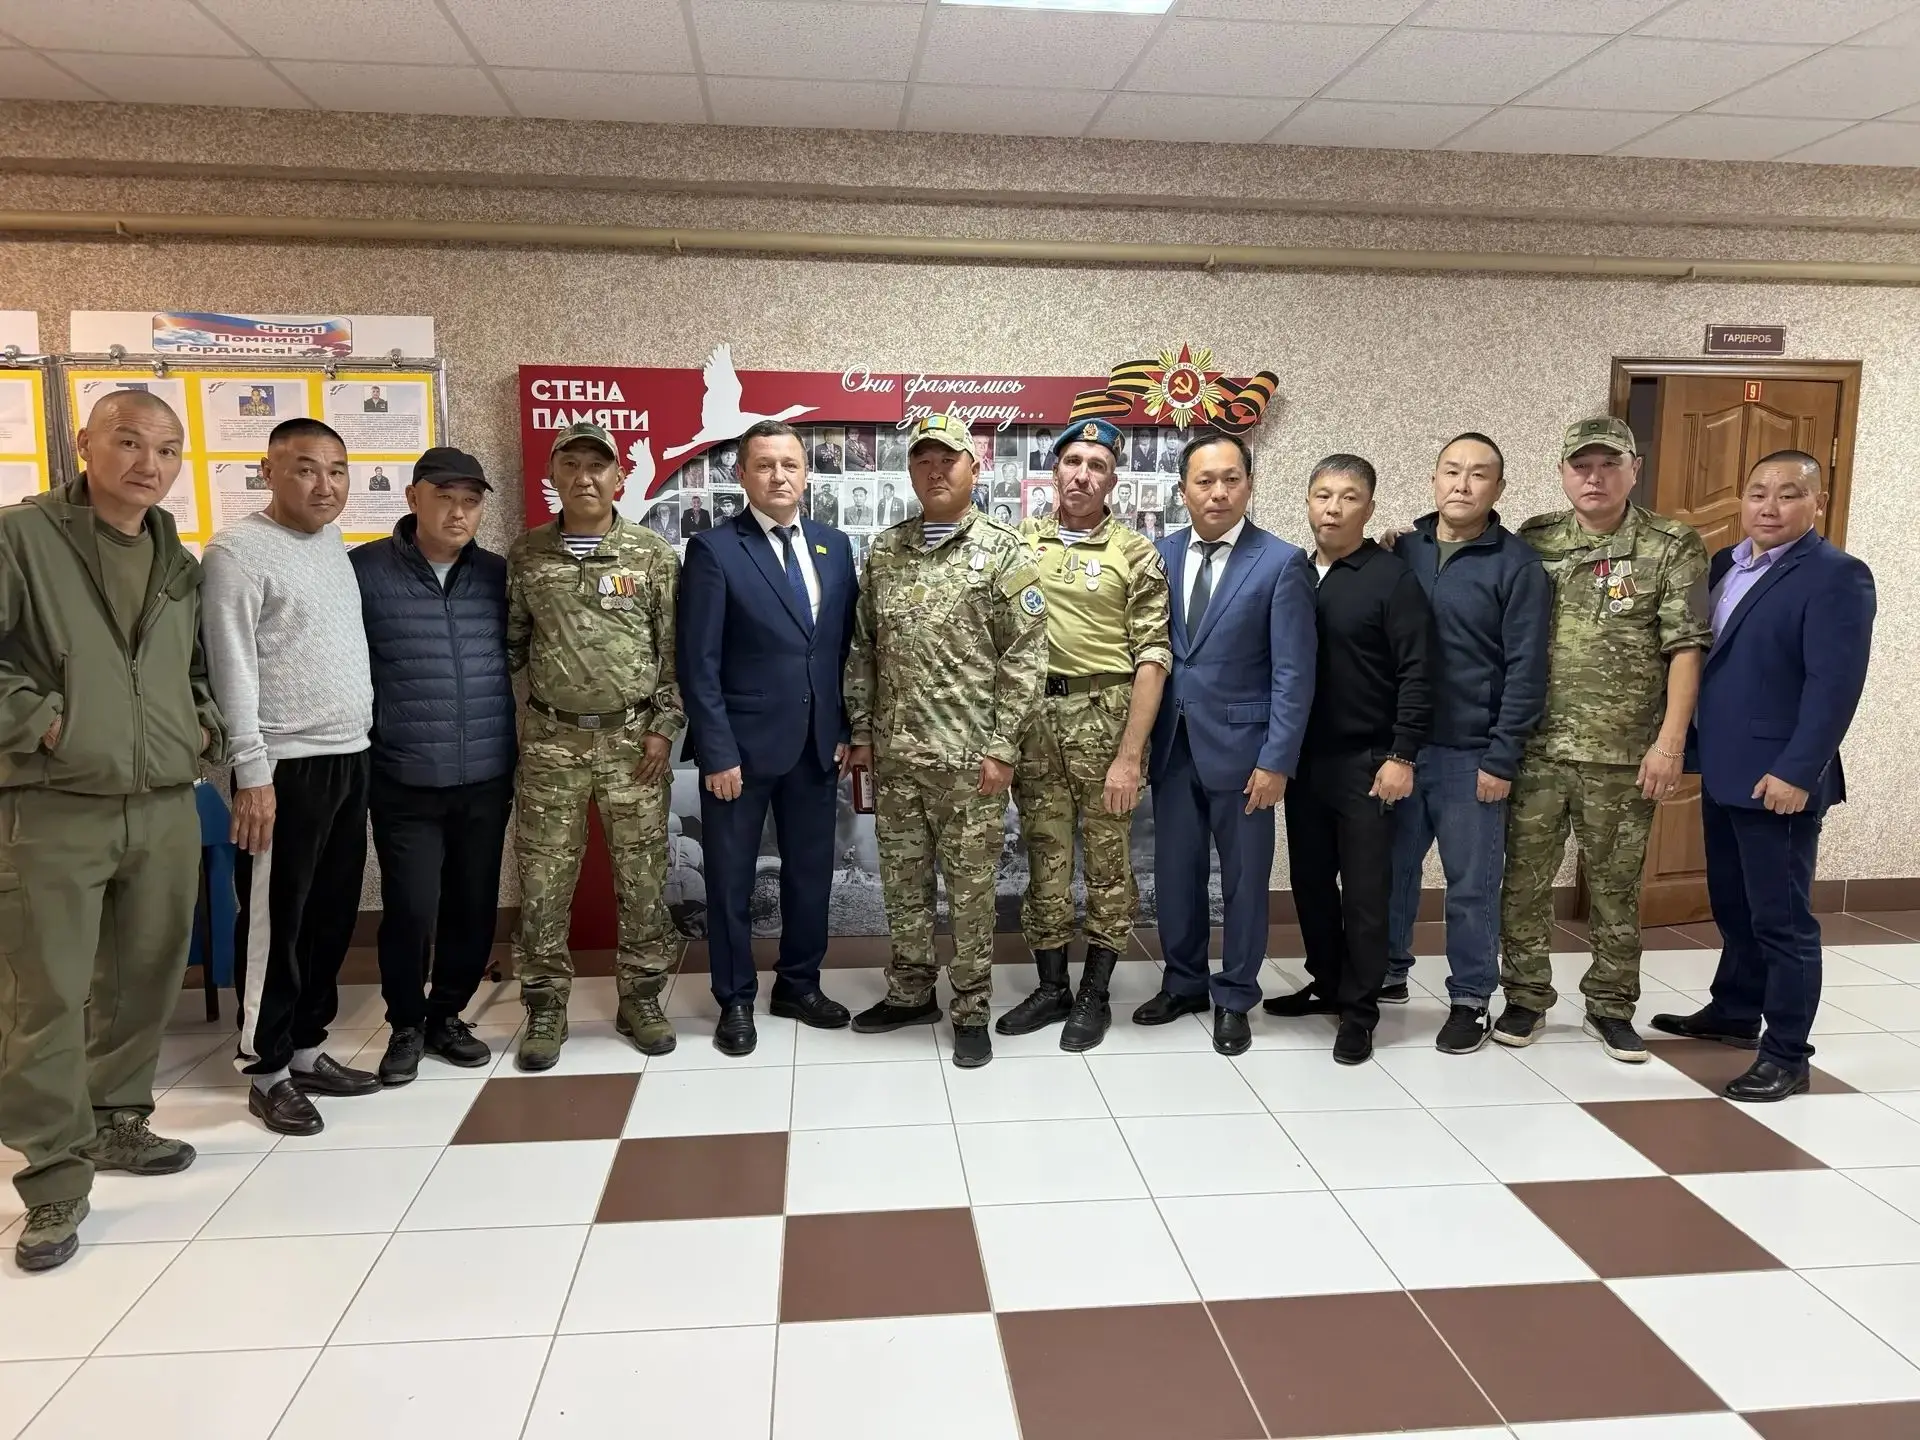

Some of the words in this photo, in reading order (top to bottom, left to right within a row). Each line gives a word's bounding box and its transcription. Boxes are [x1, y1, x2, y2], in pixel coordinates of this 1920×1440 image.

[258, 324, 323, 334] Чтим!
[214, 334, 310, 344] Помним!
[1723, 333, 1772, 344] ГАРДЕРОБ
[176, 344, 292, 355] Гордимся!
[841, 362, 896, 394] Они
[530, 379, 626, 403] СТЕНА
[1749, 384, 1757, 399] 9
[532, 408, 650, 432] ПАМЯТИ
[896, 404, 934, 431] за
